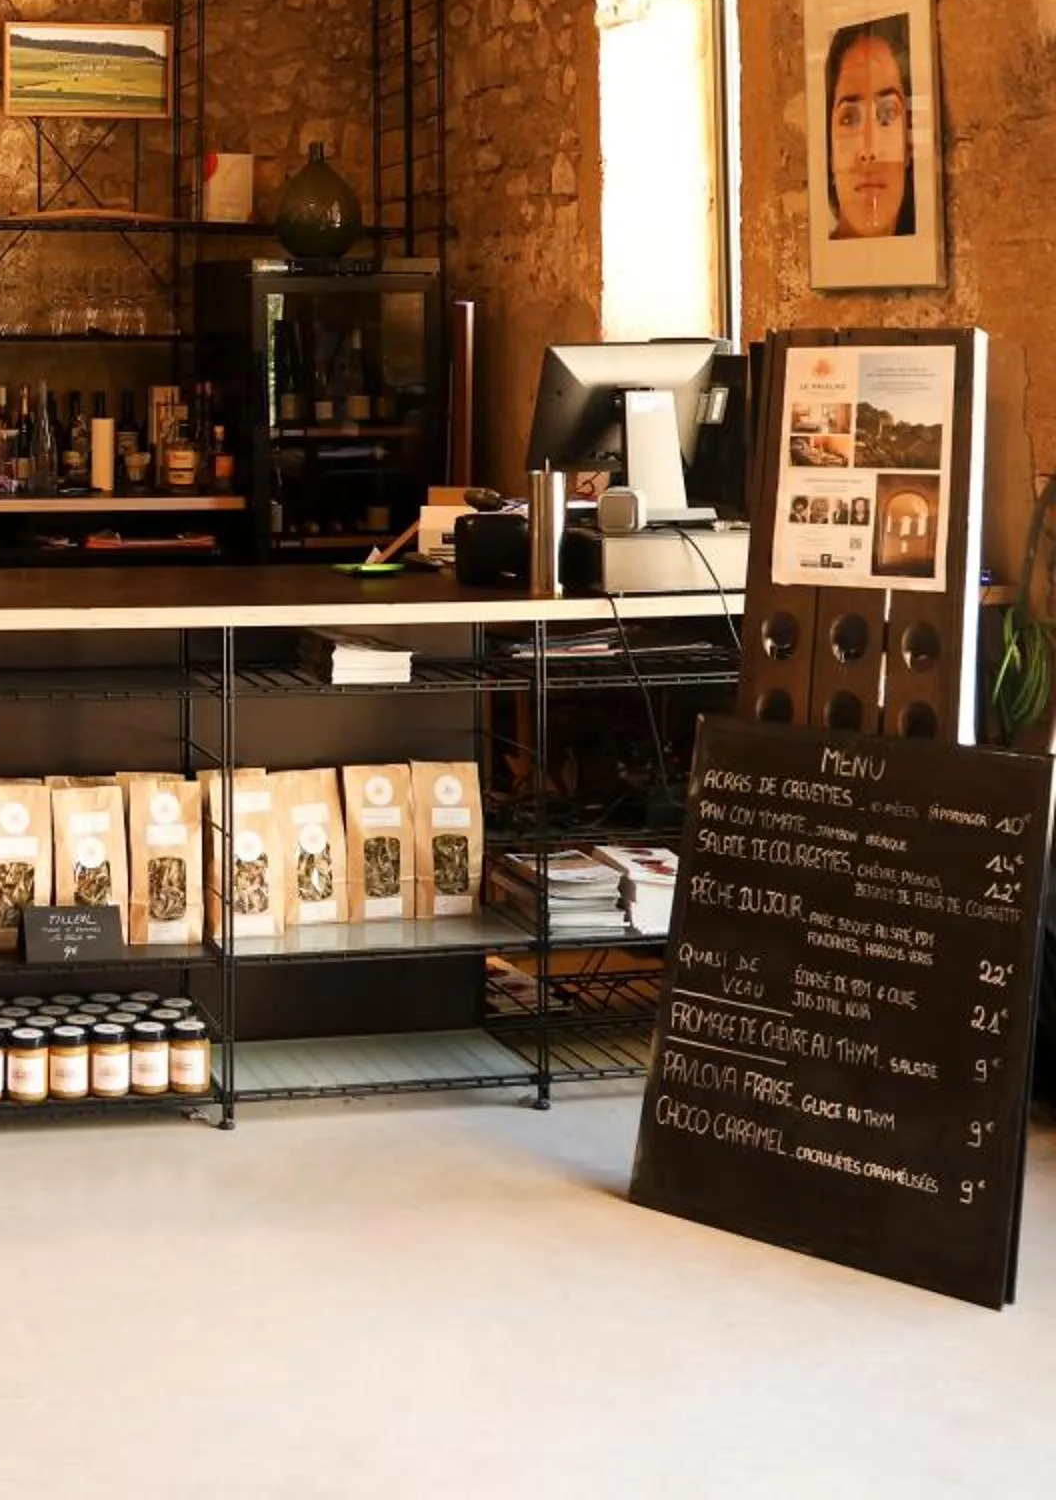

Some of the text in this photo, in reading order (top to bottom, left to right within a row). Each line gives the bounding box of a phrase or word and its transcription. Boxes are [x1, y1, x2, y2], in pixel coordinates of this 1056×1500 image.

[820, 748, 885, 780] MENU
[703, 769, 753, 793] ACRAS
[757, 776, 778, 796] DE
[781, 779, 853, 807] CREVETTES
[699, 800, 726, 821] PAN
[729, 804, 755, 826] CON
[759, 810, 807, 833] TOMATE
[697, 828, 746, 859] SALADE
[751, 837, 769, 861] DE
[769, 839, 851, 875] COURGETTES
[738, 886, 761, 913] DU
[762, 891, 803, 919] JOUR
[809, 911, 835, 929] AVEC
[875, 923, 888, 940] AU
[946, 897, 962, 915] DE
[735, 955, 761, 973] DE
[791, 991, 815, 1010] JUS
[834, 975, 848, 994] DE
[671, 1001, 737, 1041] FROMAGE
[739, 1016, 757, 1045] DE
[811, 1032, 833, 1059] AU
[836, 1037, 879, 1068] THYM
[890, 1057, 939, 1079] SALADE
[662, 1050, 895, 1131] PAVLOVA FRAISE GLACE AU THYM
[655, 1095, 711, 1135] CHOCO
[713, 1112, 787, 1156] CARAMEL
